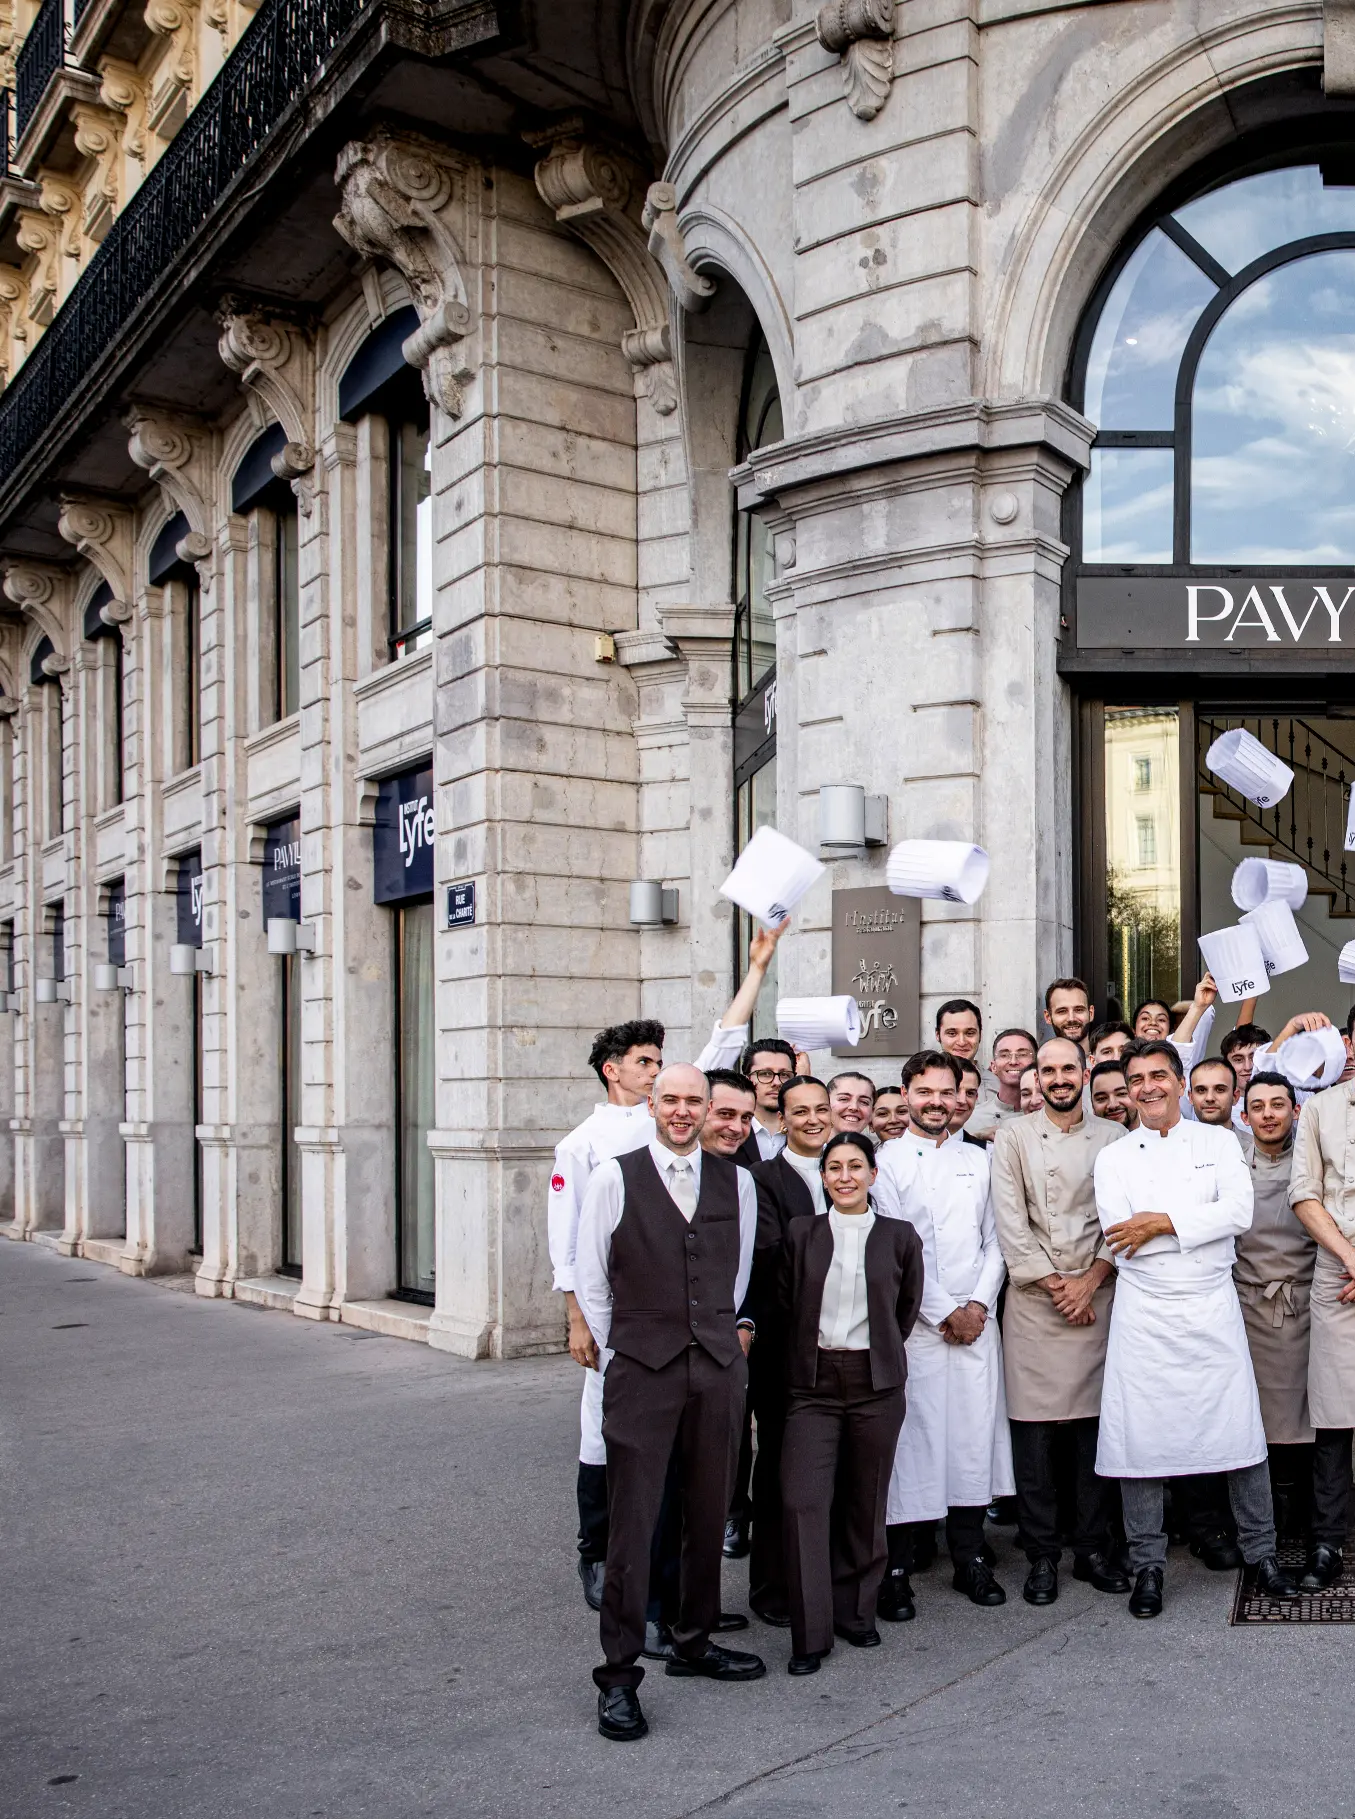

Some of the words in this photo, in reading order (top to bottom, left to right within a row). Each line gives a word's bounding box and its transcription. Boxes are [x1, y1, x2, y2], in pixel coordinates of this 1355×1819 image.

[399, 795, 434, 868] Lyfe
[455, 893, 466, 905] RUE
[858, 999, 898, 1040] yfe
